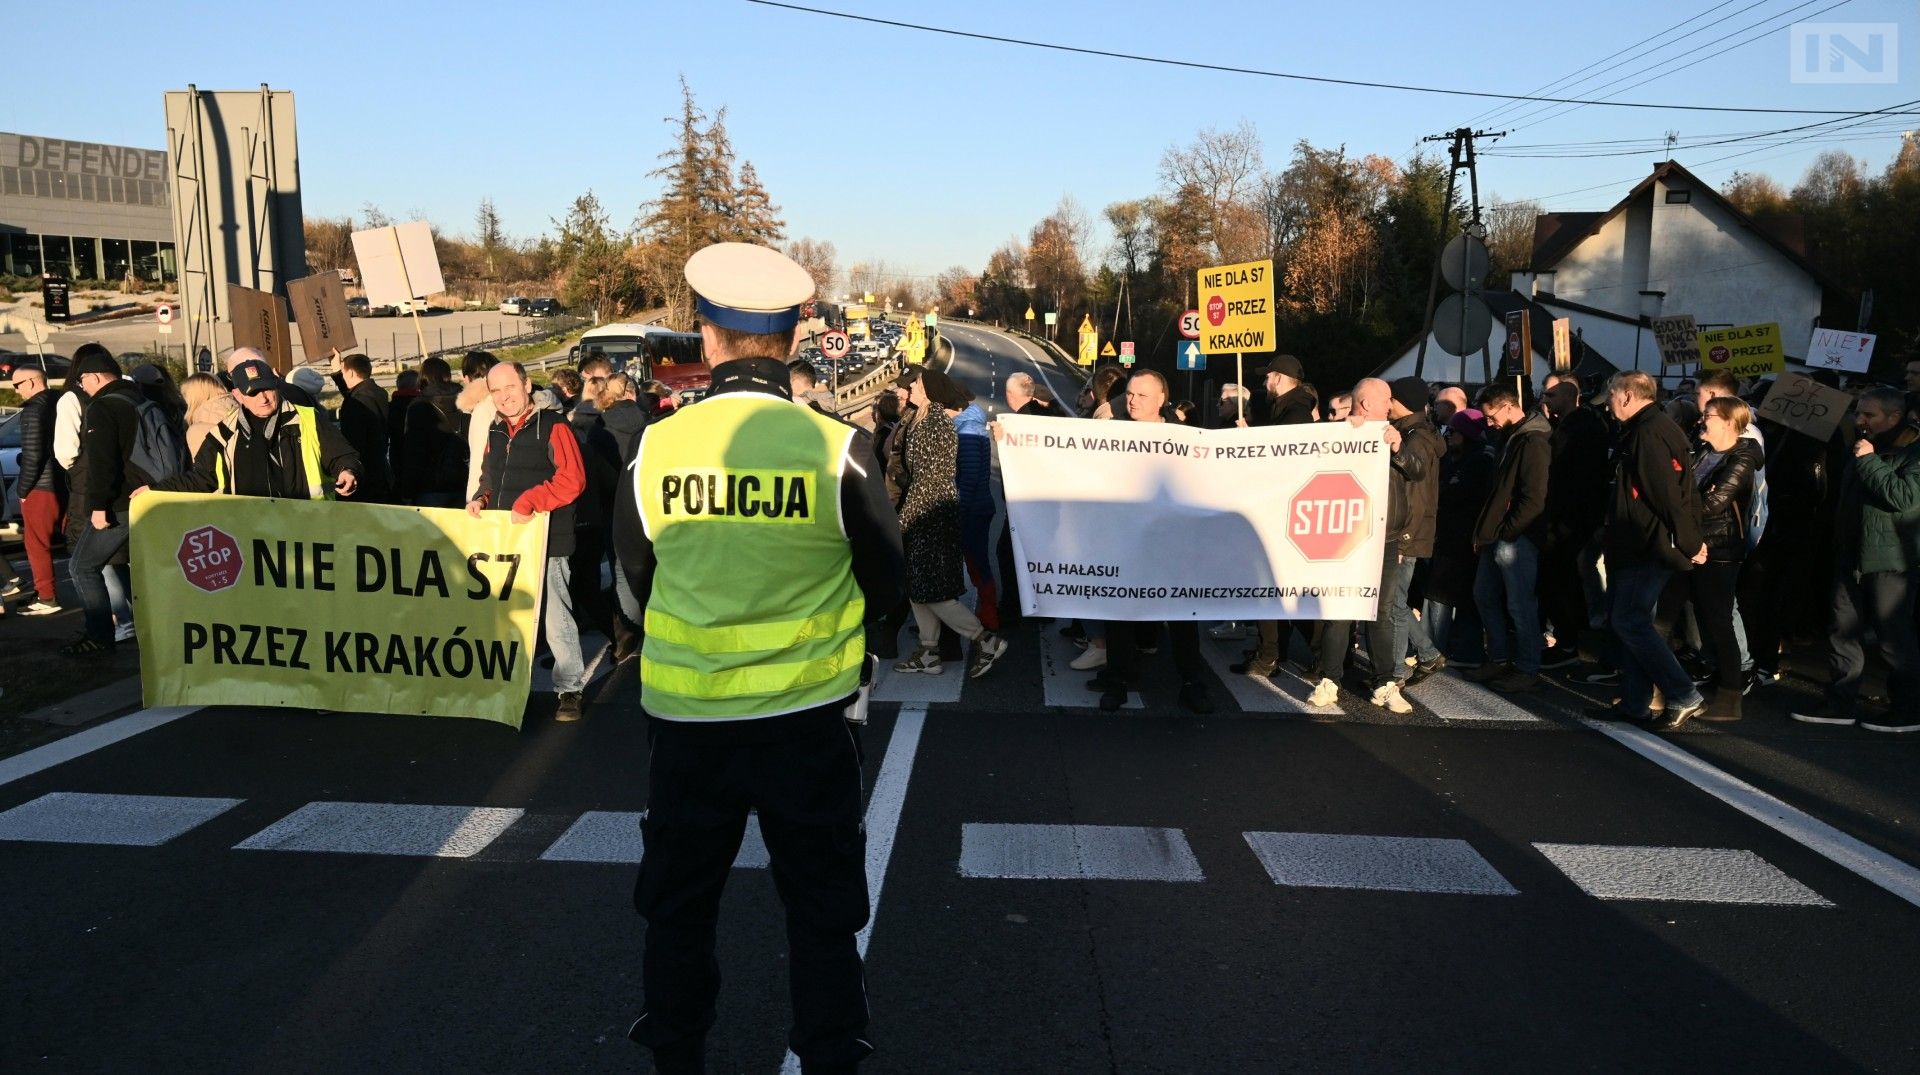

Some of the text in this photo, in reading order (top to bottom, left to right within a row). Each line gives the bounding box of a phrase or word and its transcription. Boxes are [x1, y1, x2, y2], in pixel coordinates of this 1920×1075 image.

[19, 135, 169, 182] DEFENDE
[1204, 267, 1264, 289] NIE DLA S7
[1209, 302, 1223, 311] STOP
[1228, 298, 1266, 316] PRZEZ
[312, 297, 329, 339] Kanlux
[826, 337, 844, 351] 50
[1209, 328, 1264, 350] KRAKÓW
[1705, 327, 1770, 343] NIE DLA S7
[1818, 332, 1870, 352] NIE!
[1732, 344, 1773, 357] PRZEZ
[1725, 363, 1773, 376] AKÓW
[1764, 397, 1829, 421] STOP
[1006, 433, 1378, 459] NIE! DLA WARIANTÓW S7 PRZEZ WRZĄSOWICE
[662, 474, 809, 518] POLICJA
[1294, 498, 1365, 535] STOP
[189, 530, 213, 554] S7
[187, 547, 231, 573] STOP
[253, 539, 521, 601] NIE DLA S7
[1027, 561, 1119, 577] DLA HAŁASU!
[1033, 583, 1378, 599] LA ZWIĘKSZONEGO ZANIECZYSZCZENIA POWIETRZA
[183, 622, 519, 682] PRZEZ KRAKÓW
